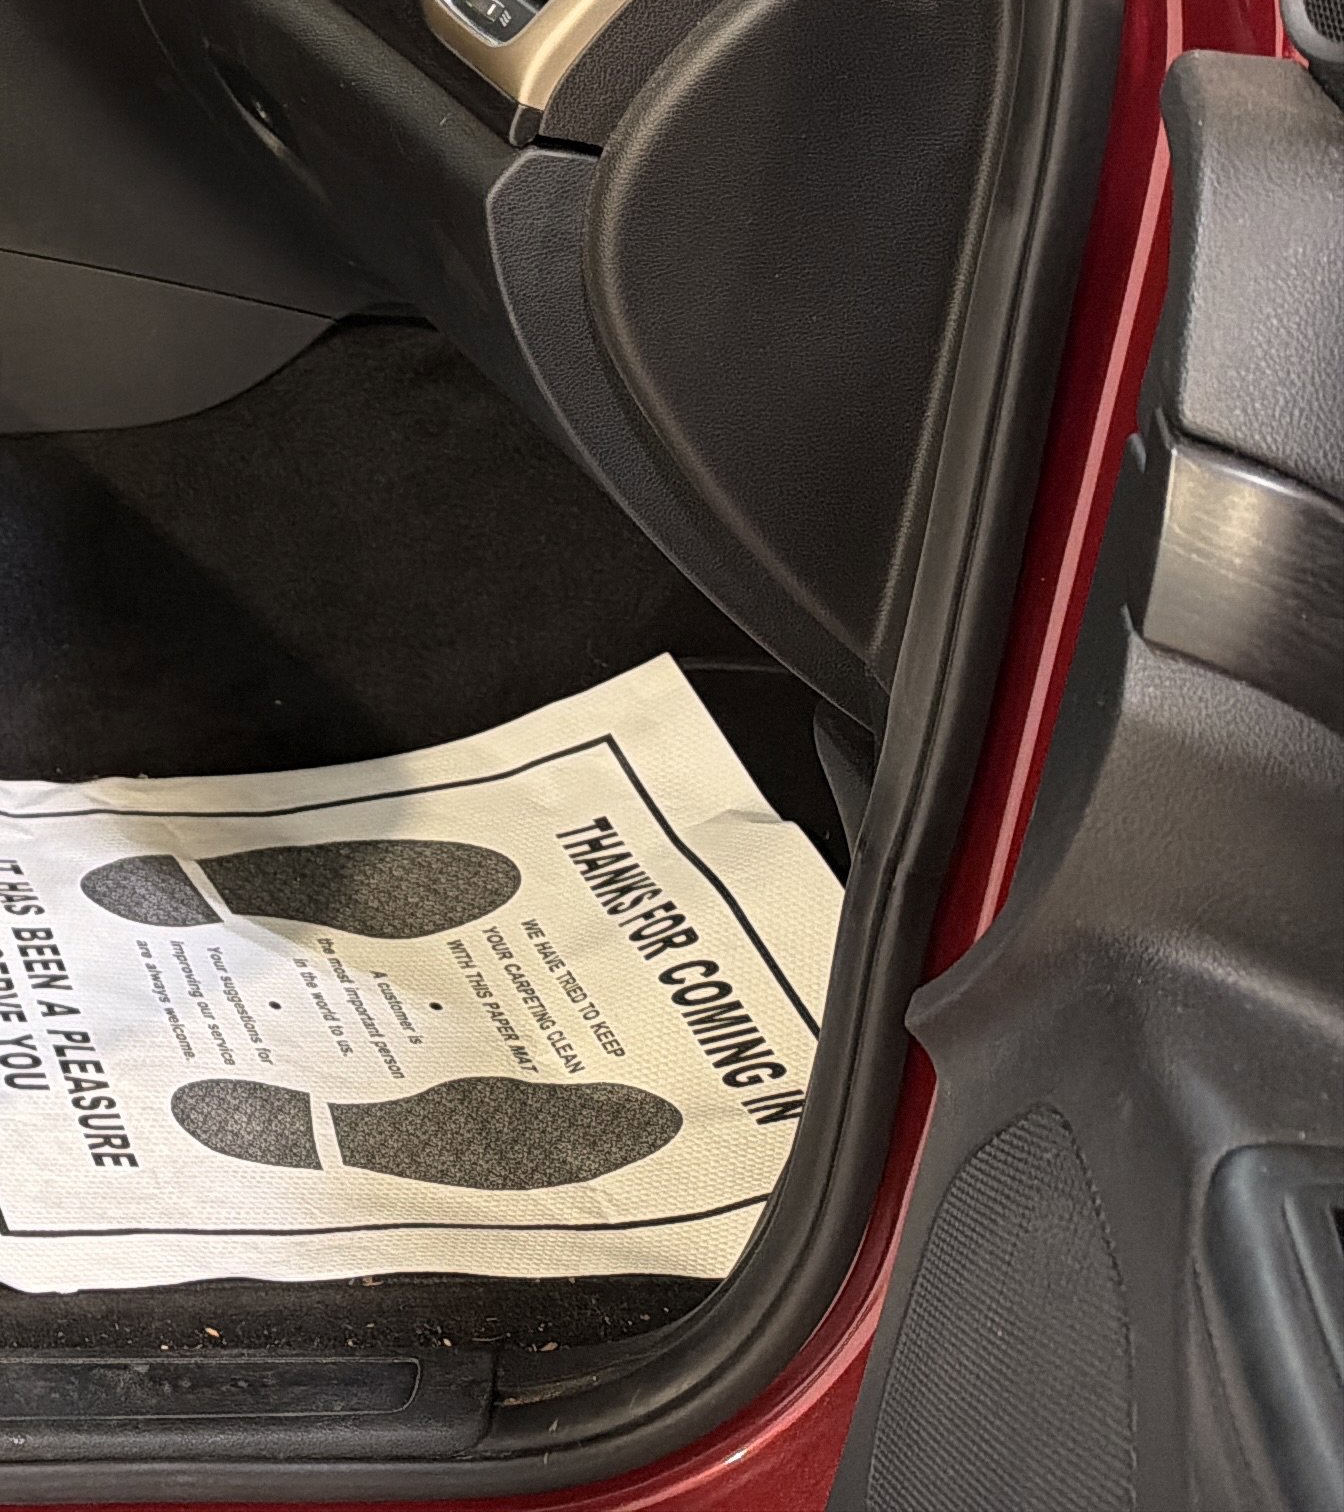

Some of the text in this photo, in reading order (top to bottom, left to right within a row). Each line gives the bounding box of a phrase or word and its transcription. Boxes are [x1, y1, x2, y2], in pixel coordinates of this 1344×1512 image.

[11, 927, 74, 990] BEEN
[37, 999, 81, 1018] A
[136, 940, 196, 1062] are always welcome.
[170, 940, 236, 1066] improving our service
[207, 946, 274, 1066] Your suggestions for
[293, 958, 353, 1057] in the world to us.
[317, 938, 406, 1079] the most important person
[369, 970, 424, 1045] A customer is
[446, 939, 539, 1074] WITH THIS PAPER MAT
[482, 926, 586, 1074] YOUR CARPETING CLEAN
[521, 918, 626, 1058] WE HAVE TRIED TO KEEP
[556, 816, 806, 1126] THANKS FOR COMING IN
[46, 1029, 140, 1168] PLEASURE
